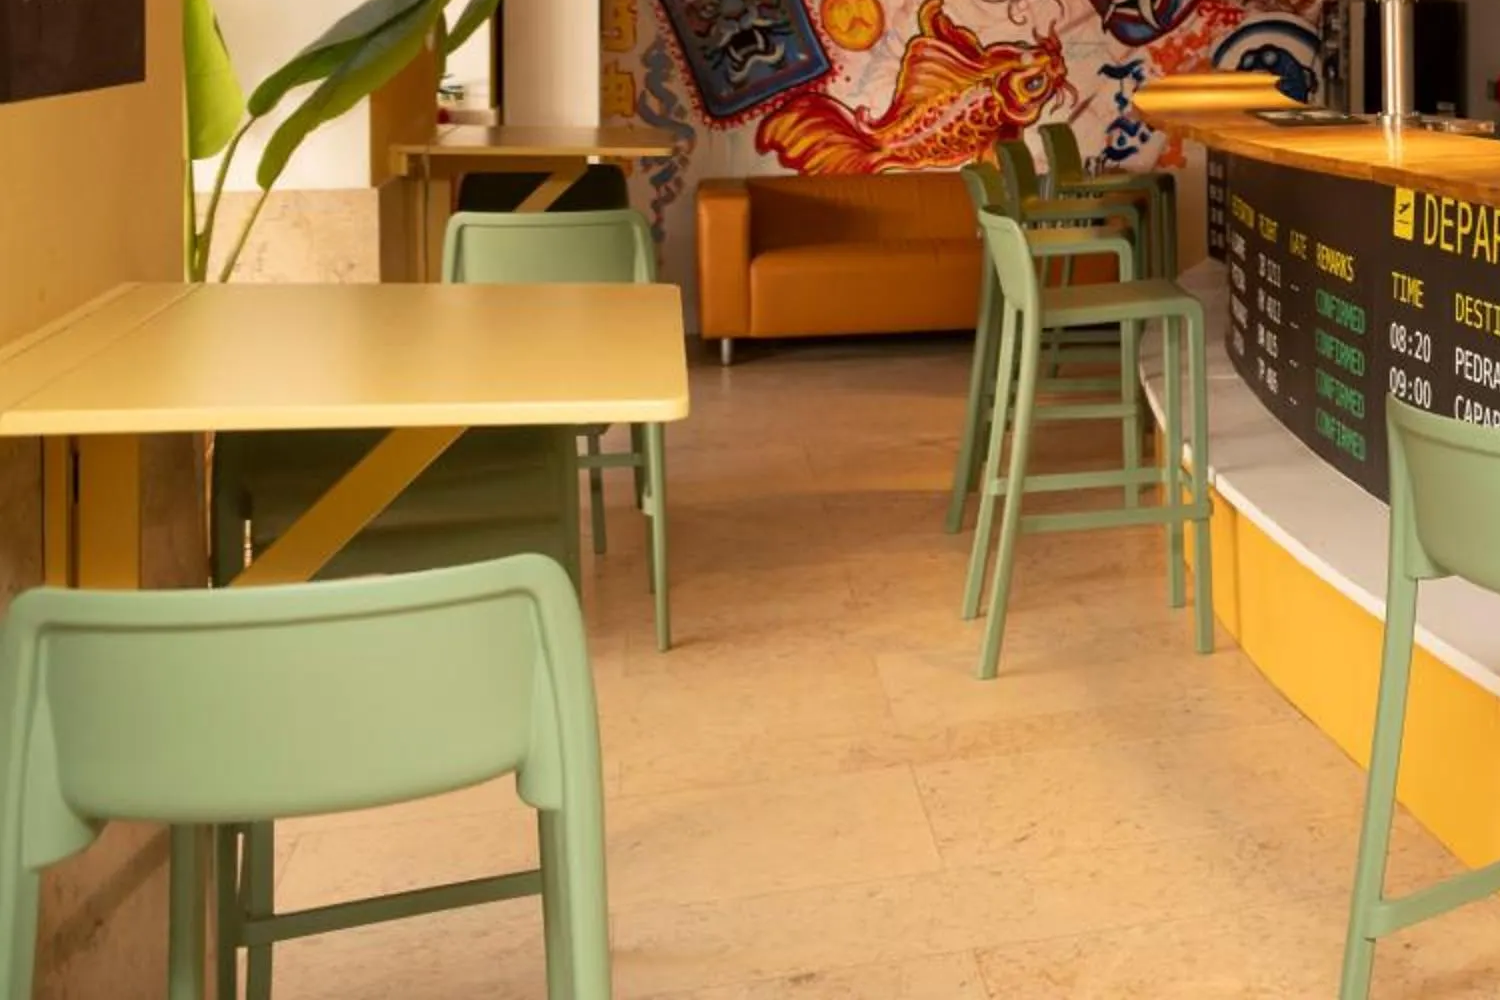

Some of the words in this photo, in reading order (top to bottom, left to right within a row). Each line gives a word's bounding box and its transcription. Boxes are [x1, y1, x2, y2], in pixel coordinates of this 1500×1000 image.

[1316, 241, 1356, 283] REMARKS
[1391, 271, 1425, 309] TIME
[1389, 322, 1432, 364] 08:20
[1389, 366, 1432, 410] 09:00
